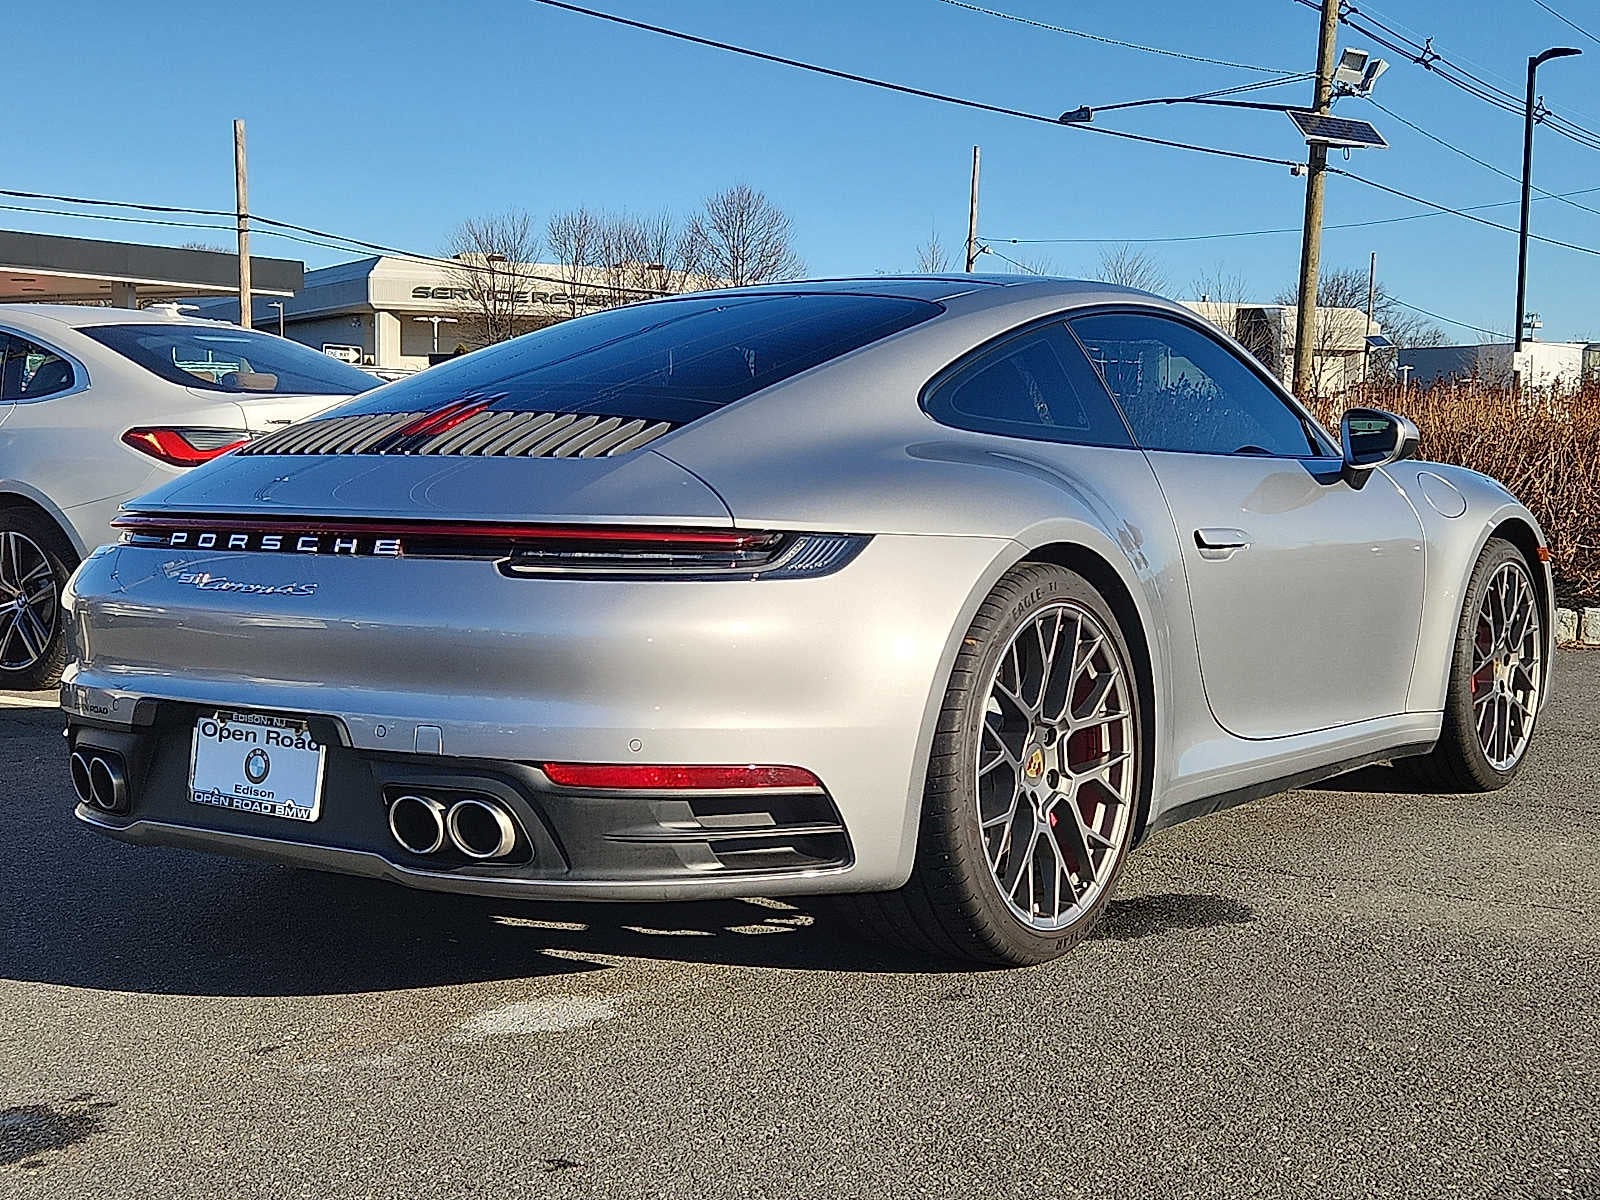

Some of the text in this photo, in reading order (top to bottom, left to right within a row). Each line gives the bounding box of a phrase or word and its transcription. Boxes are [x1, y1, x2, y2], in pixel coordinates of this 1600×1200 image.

[169, 532, 401, 555] PORSCHE
[1012, 587, 1042, 620] EAGLE
[232, 713, 286, 727] EDISON, NJ
[201, 721, 257, 743] Open
[234, 784, 275, 799] Edison
[194, 792, 310, 819] OPEN ROAD BMW
